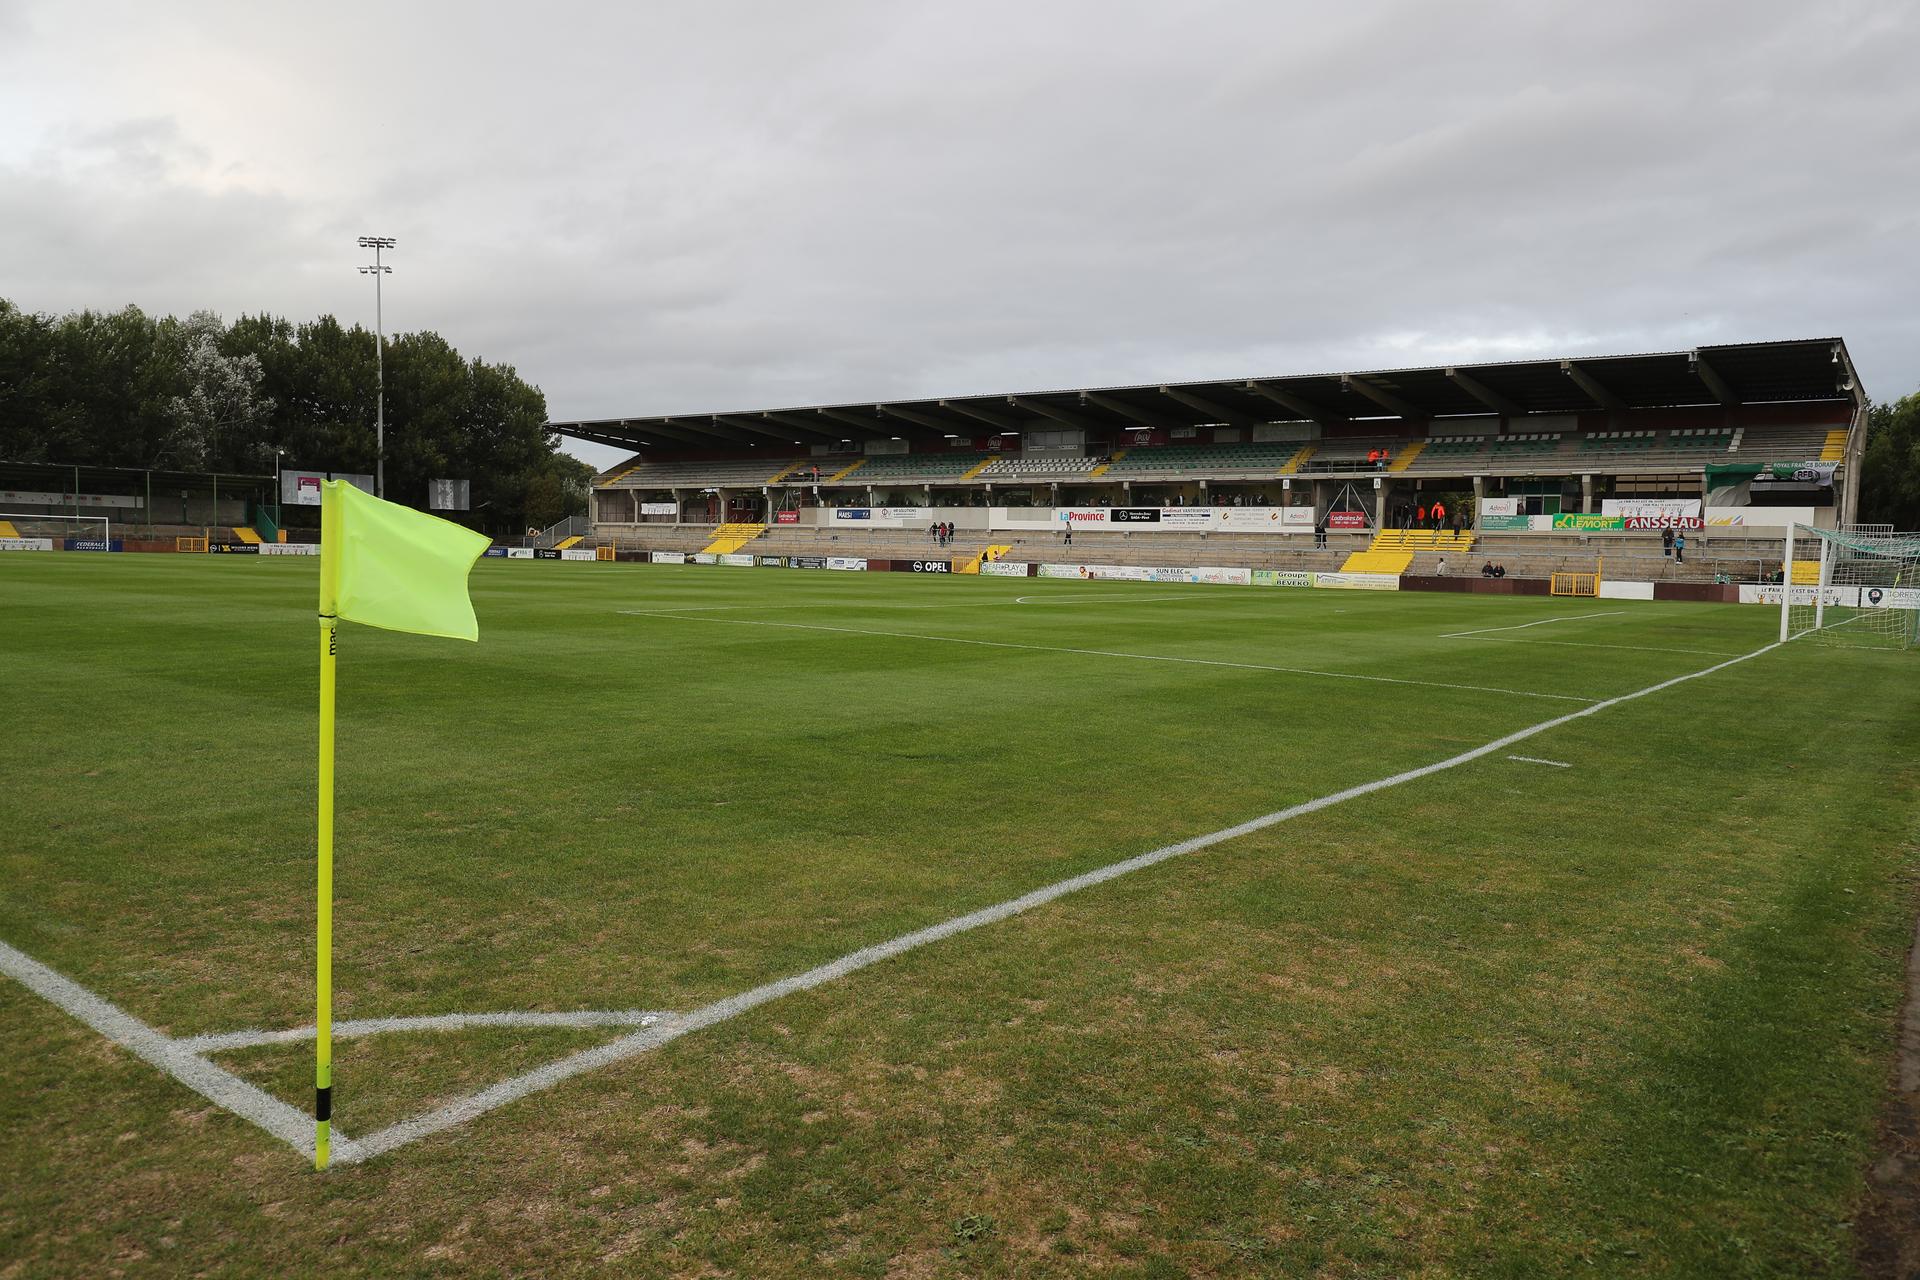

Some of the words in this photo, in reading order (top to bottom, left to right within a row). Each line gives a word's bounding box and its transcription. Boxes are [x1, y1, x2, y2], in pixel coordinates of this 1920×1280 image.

[1571, 520, 1618, 528] LEMORT
[1629, 517, 1699, 529] ANSSEAU
[925, 561, 947, 572] OPEL
